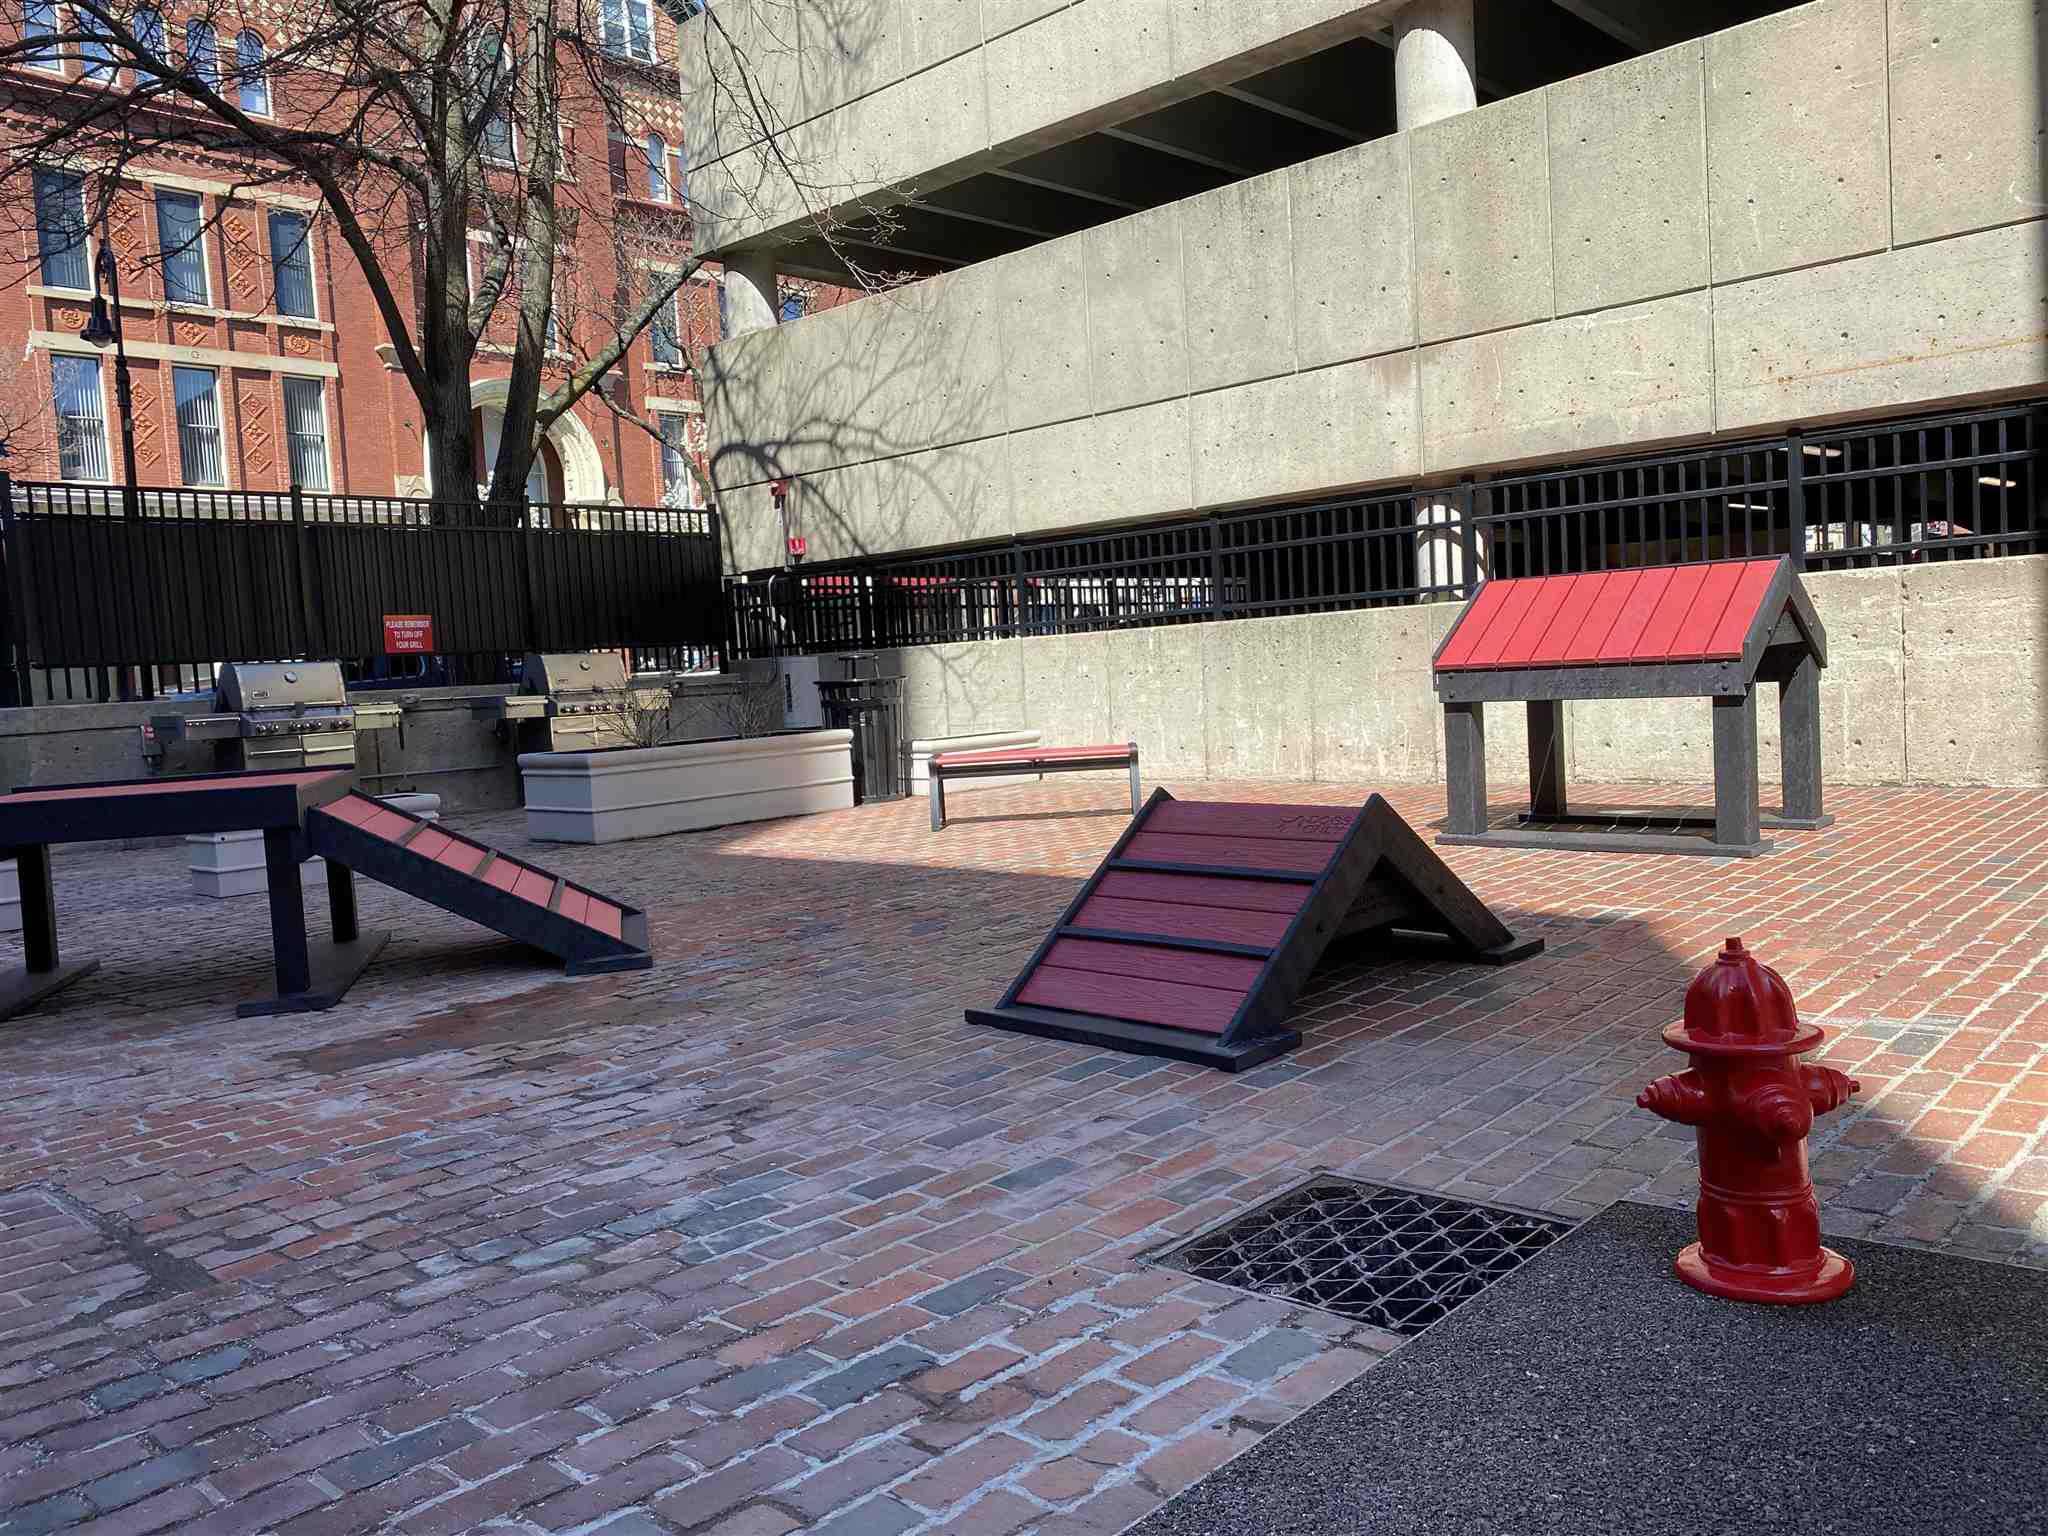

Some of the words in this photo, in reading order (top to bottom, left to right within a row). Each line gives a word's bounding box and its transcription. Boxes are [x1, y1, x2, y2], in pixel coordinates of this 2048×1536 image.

[393, 631, 401, 640] TO
[401, 631, 414, 640] TURN
[414, 631, 424, 640] OFF
[396, 641, 409, 649] YOUR
[410, 641, 424, 649] GRILL
